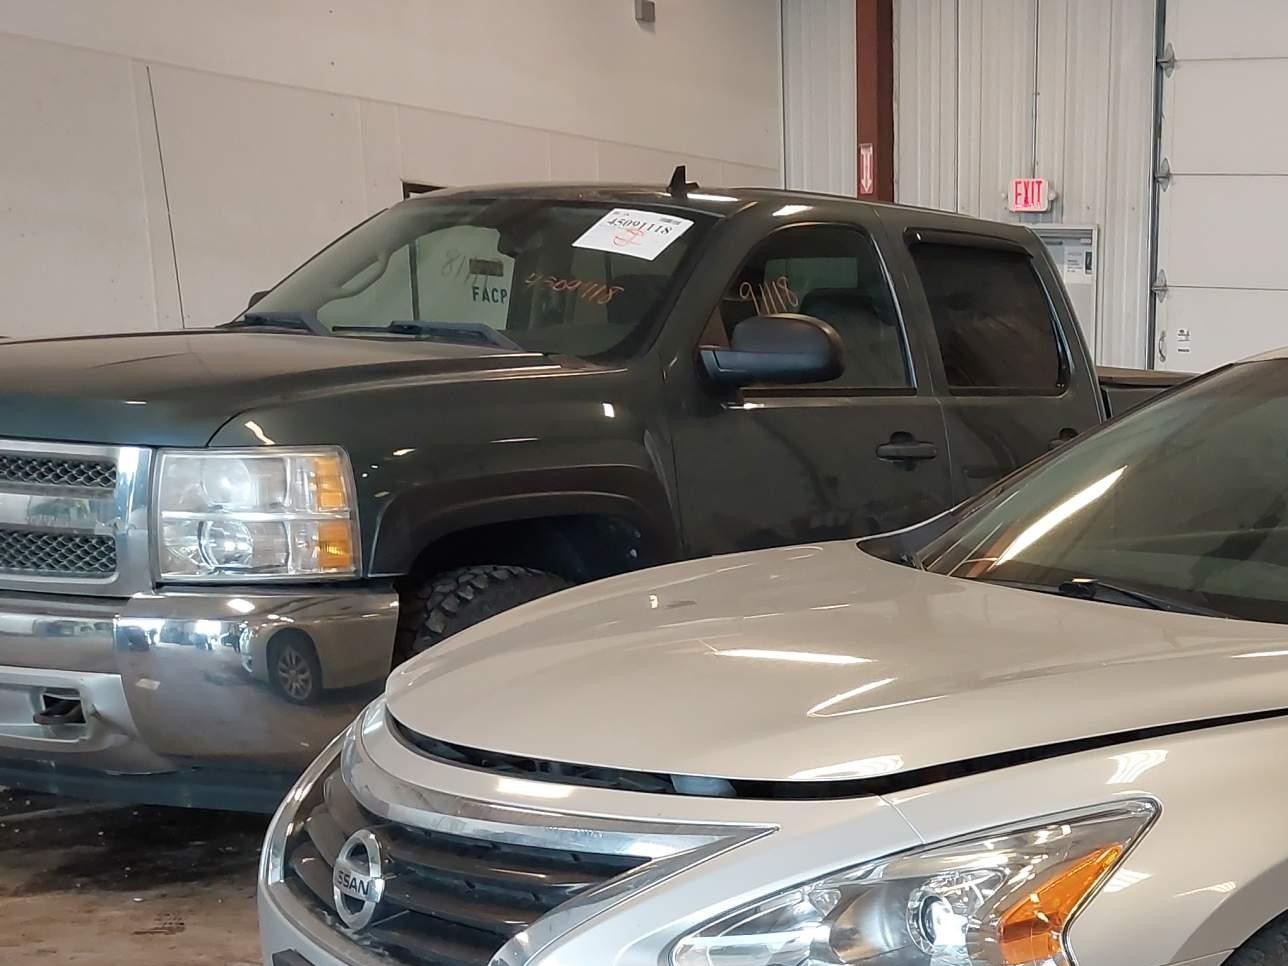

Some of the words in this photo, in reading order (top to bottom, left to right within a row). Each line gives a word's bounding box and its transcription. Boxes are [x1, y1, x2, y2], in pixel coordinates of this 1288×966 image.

[1014, 180, 1042, 208] EXIT
[606, 217, 673, 235] 45091118
[472, 285, 508, 305] FACP
[335, 869, 370, 896] SSAN
